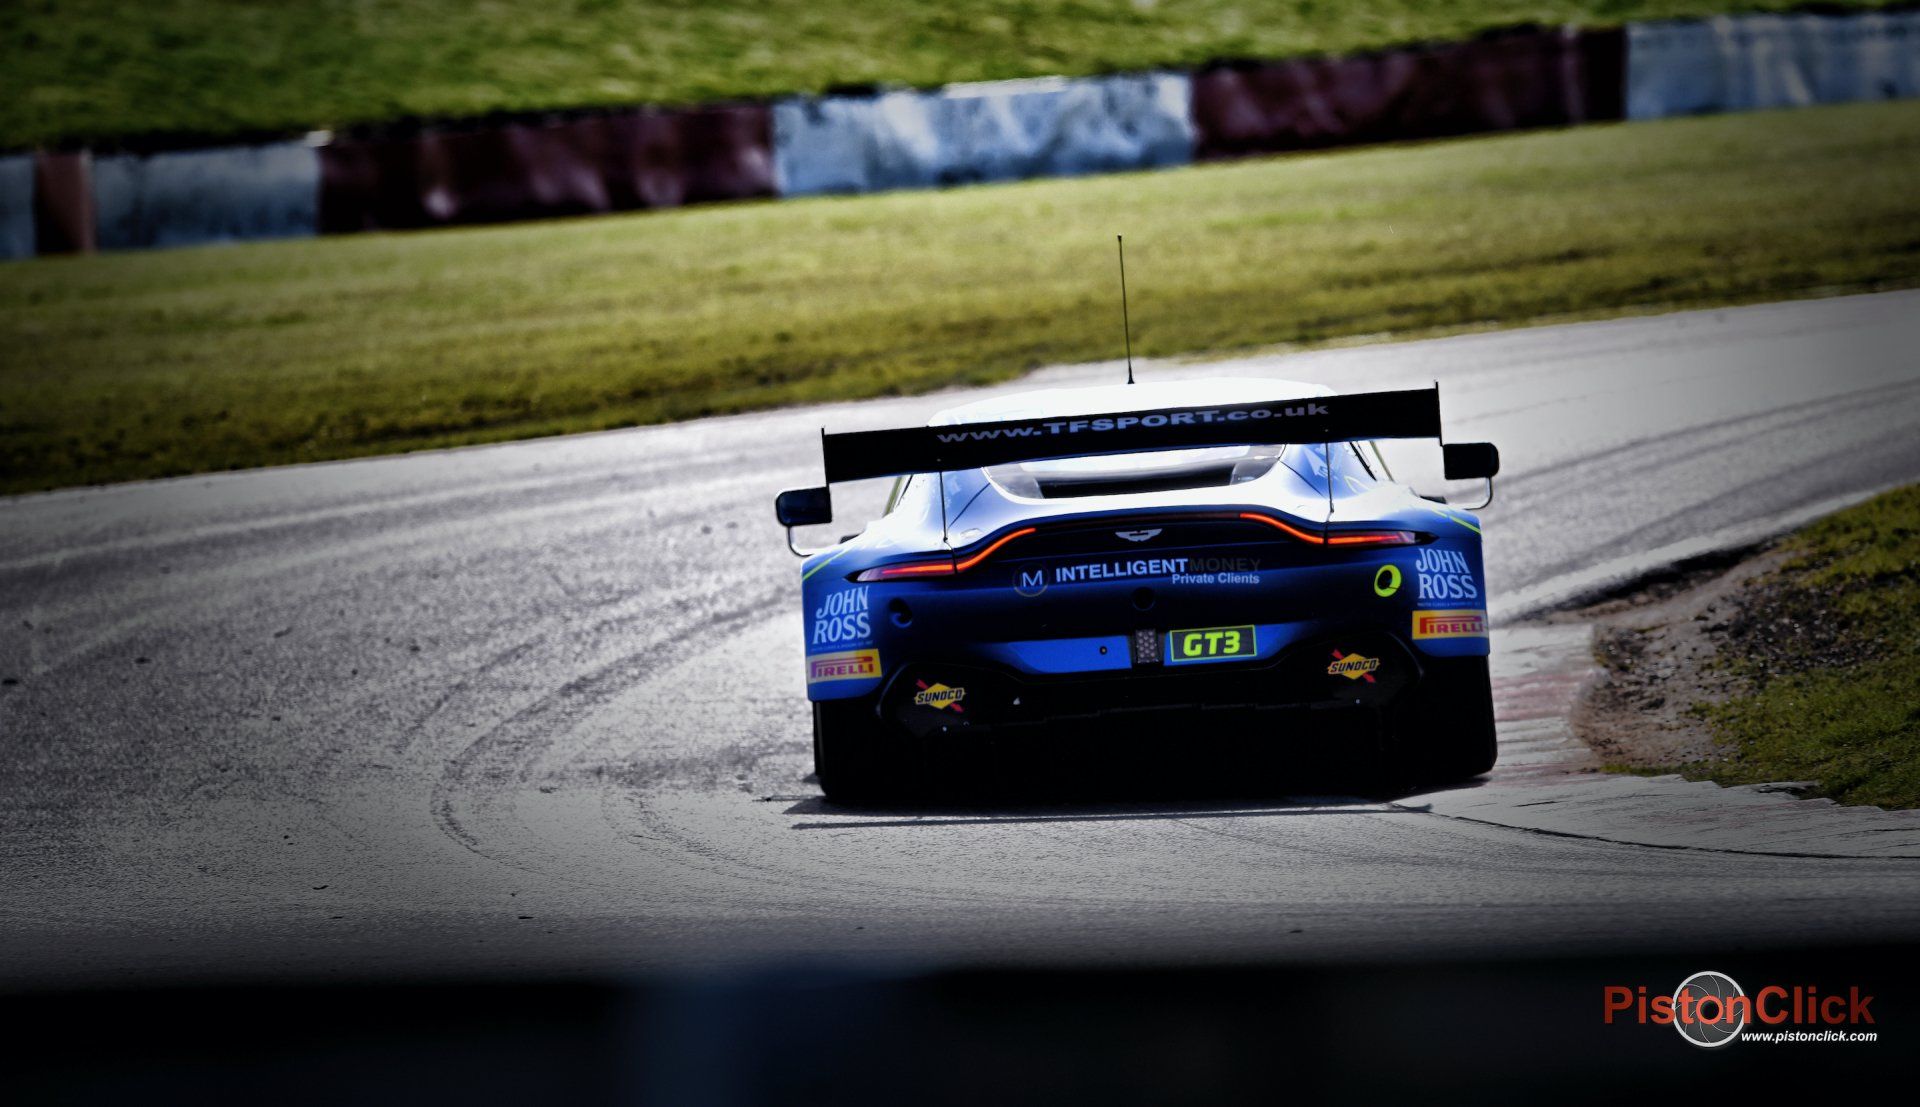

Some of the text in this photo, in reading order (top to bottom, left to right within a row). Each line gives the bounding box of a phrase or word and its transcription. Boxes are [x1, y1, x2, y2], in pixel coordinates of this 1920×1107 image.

[936, 402, 1330, 443] www.TFSPORT.co.uk
[1415, 548, 1471, 574] JOHN
[1171, 572, 1260, 584] Private Clients
[1418, 573, 1478, 600] ROSS
[815, 585, 870, 619] JOHN
[812, 611, 872, 645] ROSS
[1419, 615, 1484, 635] PIRELLI
[1183, 630, 1241, 656] GT3
[810, 656, 874, 679] PIRELLI
[1329, 658, 1378, 674] SUNOCO
[916, 687, 965, 705] SUNOCO
